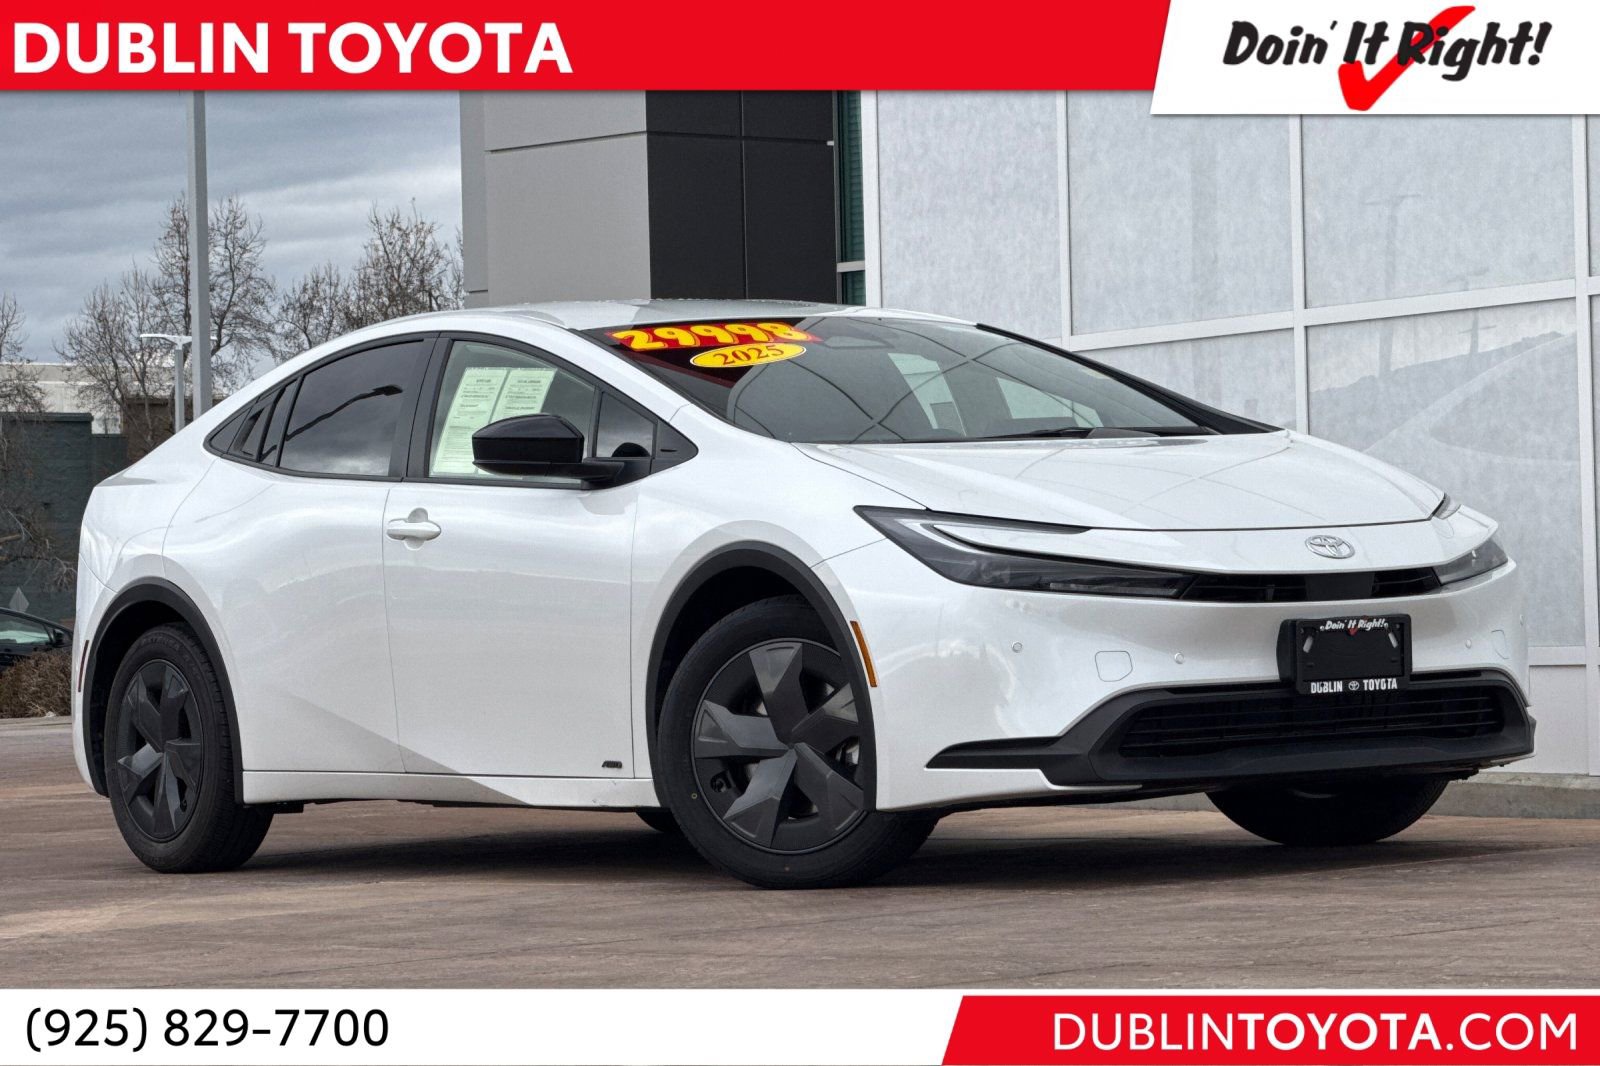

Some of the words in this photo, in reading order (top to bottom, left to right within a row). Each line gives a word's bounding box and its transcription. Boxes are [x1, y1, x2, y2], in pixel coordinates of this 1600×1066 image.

[612, 323, 806, 351] 29998
[713, 344, 785, 366] 2025
[1347, 619, 1358, 629] It
[1310, 680, 1343, 694] DUBLIN
[1362, 678, 1398, 691] TOYOTA
